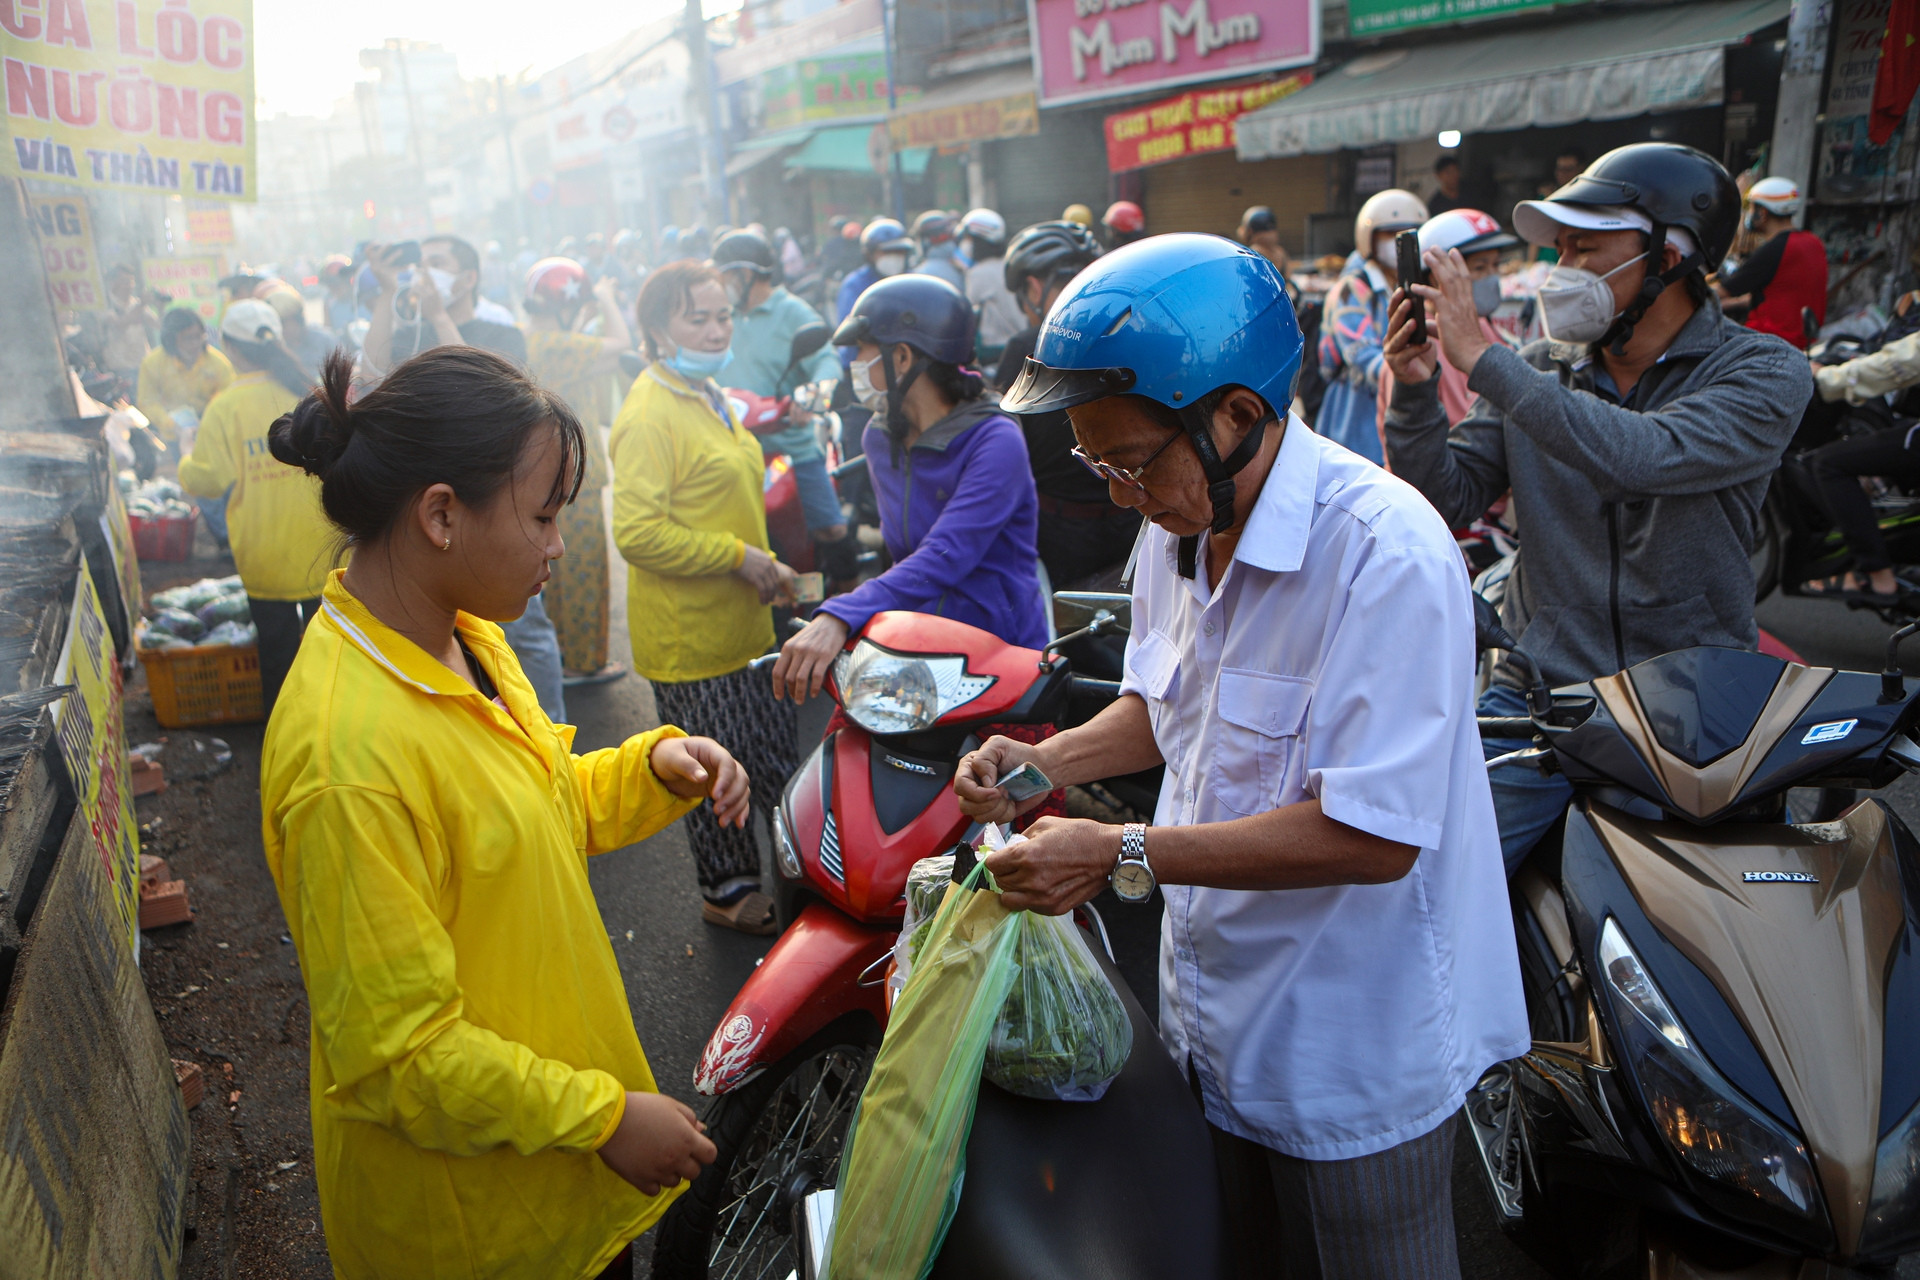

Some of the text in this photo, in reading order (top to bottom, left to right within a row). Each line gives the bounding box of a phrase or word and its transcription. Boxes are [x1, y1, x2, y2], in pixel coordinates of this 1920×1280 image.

[1069, 0, 1260, 81] Mum Mum
[4, 57, 244, 147] NƯỚNG
[14, 136, 79, 178] VÍA
[191, 156, 244, 196] TÀI
[1810, 721, 1852, 738] FI
[884, 754, 937, 775] HONDA
[1743, 871, 1820, 882] HONDA
